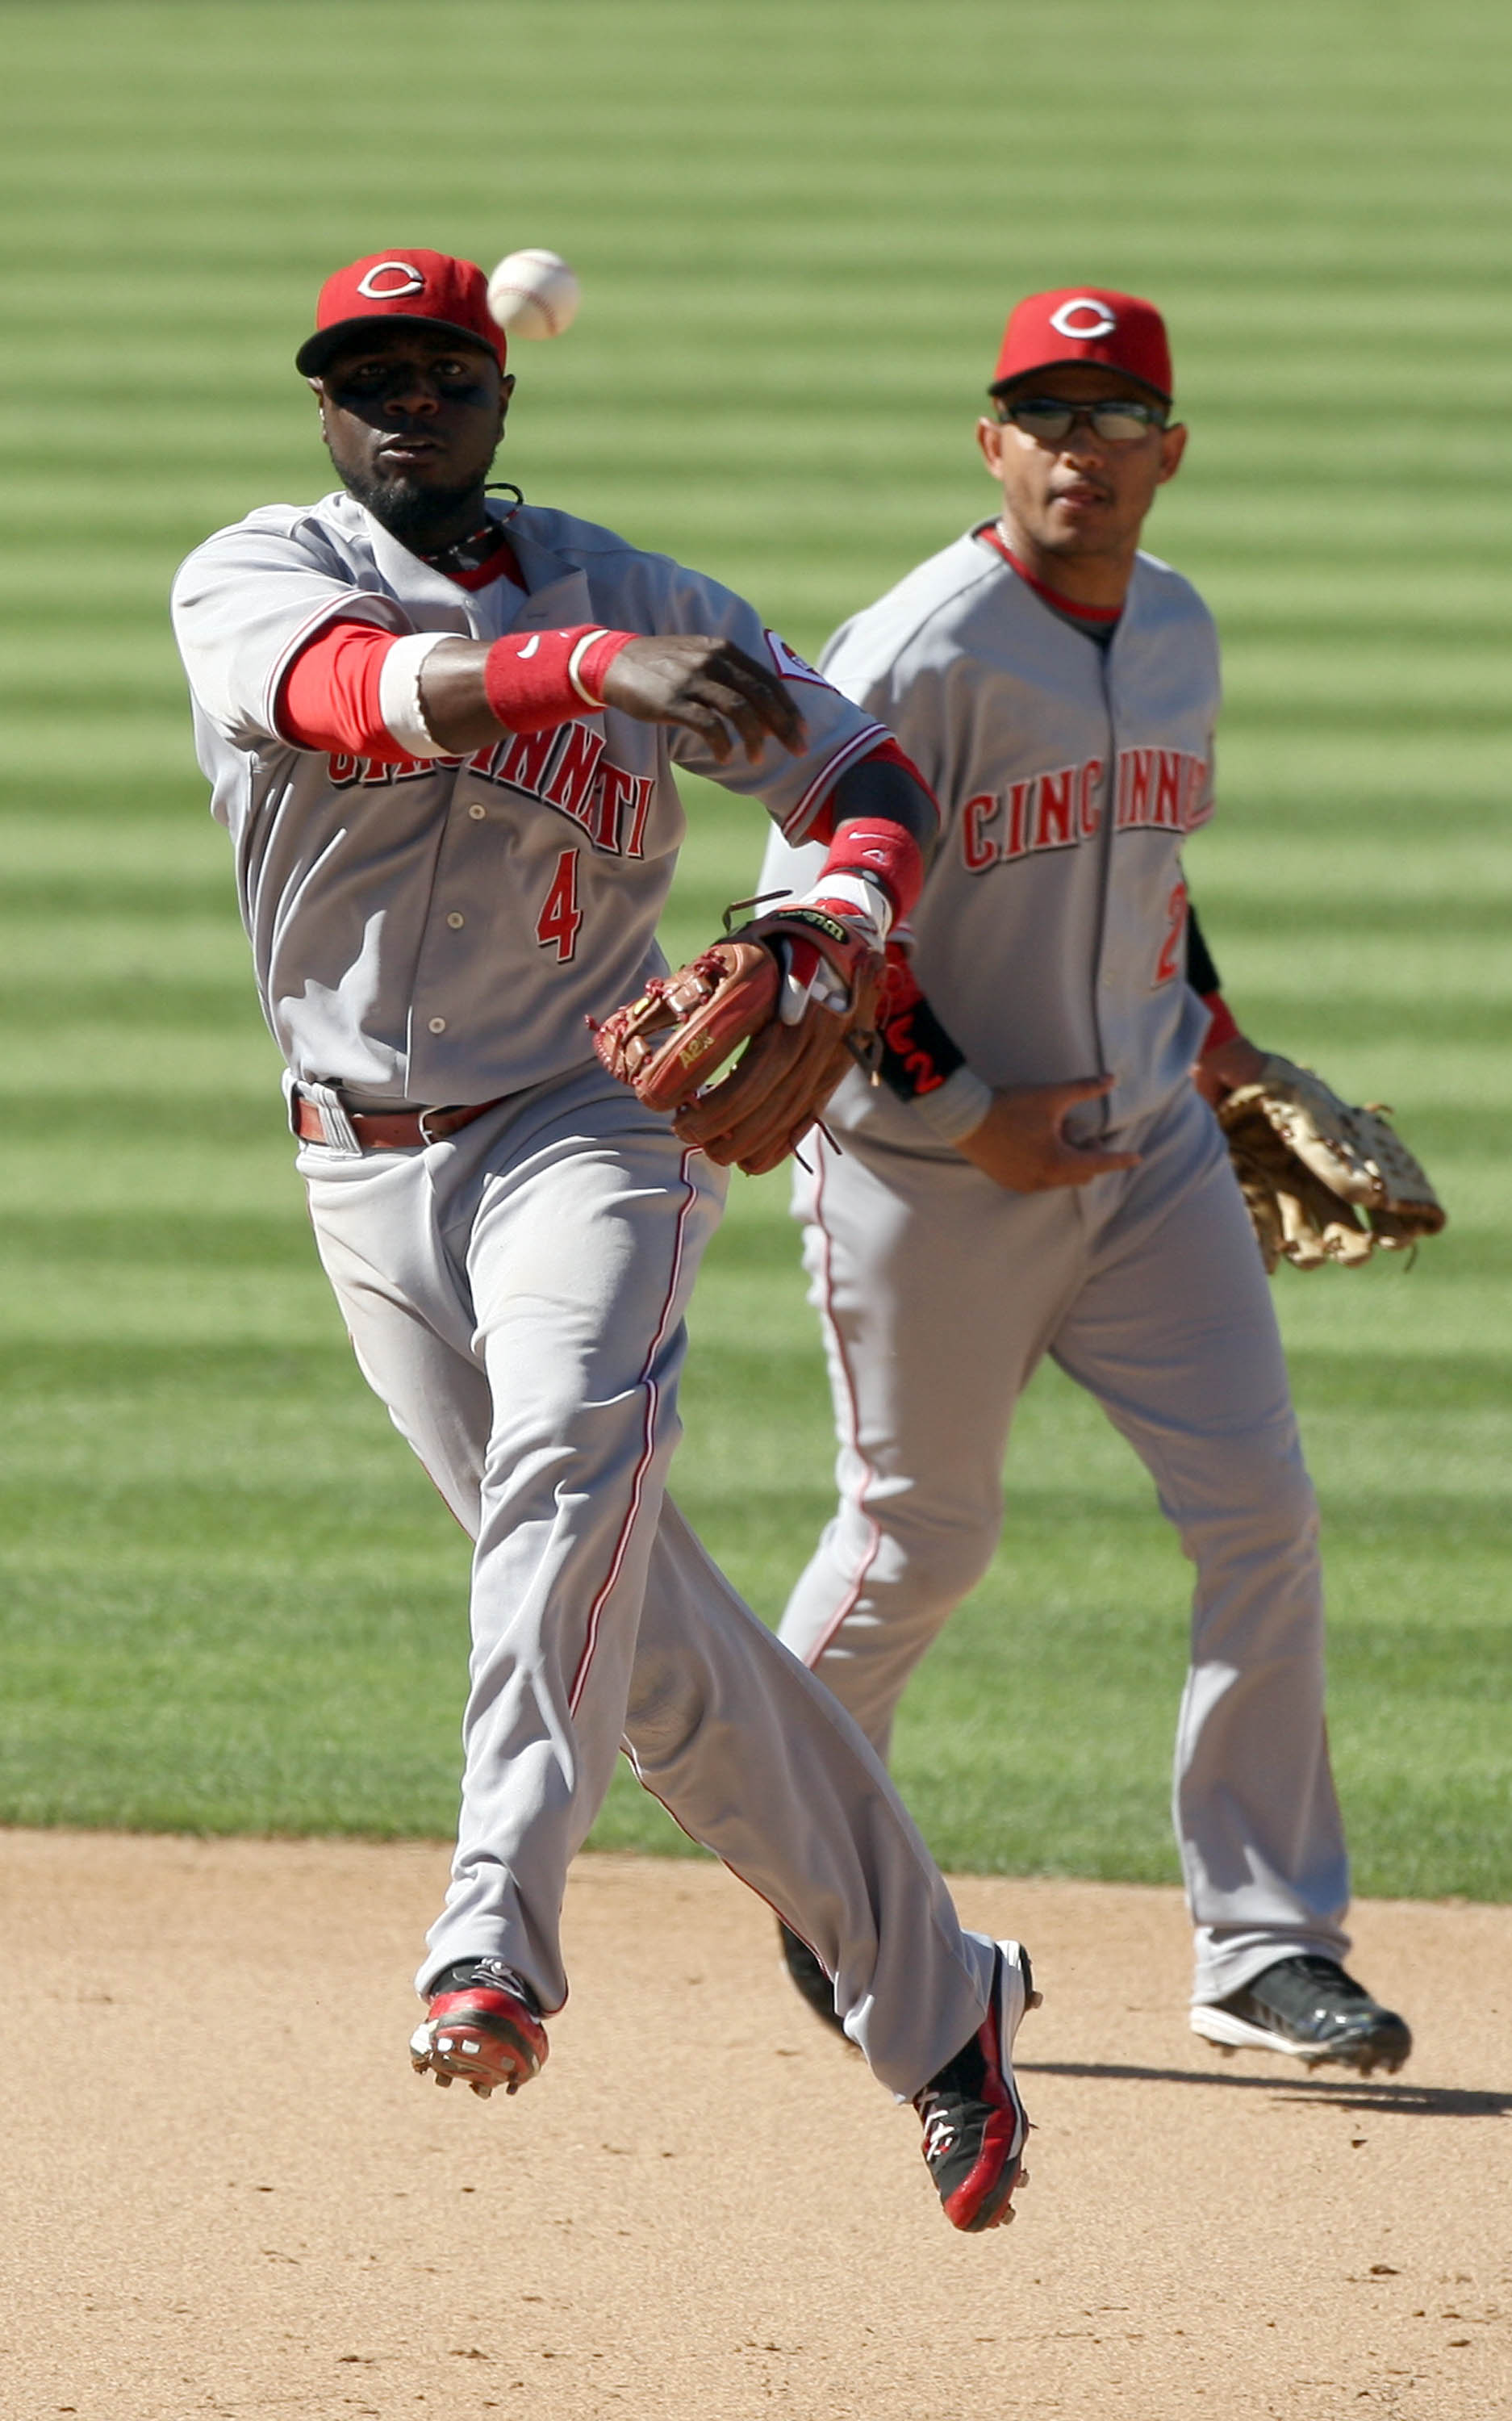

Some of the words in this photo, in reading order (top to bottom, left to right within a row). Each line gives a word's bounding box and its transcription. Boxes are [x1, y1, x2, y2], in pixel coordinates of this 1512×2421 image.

[357, 260, 427, 299] C
[1050, 298, 1117, 340] C
[536, 847, 582, 964] 4
